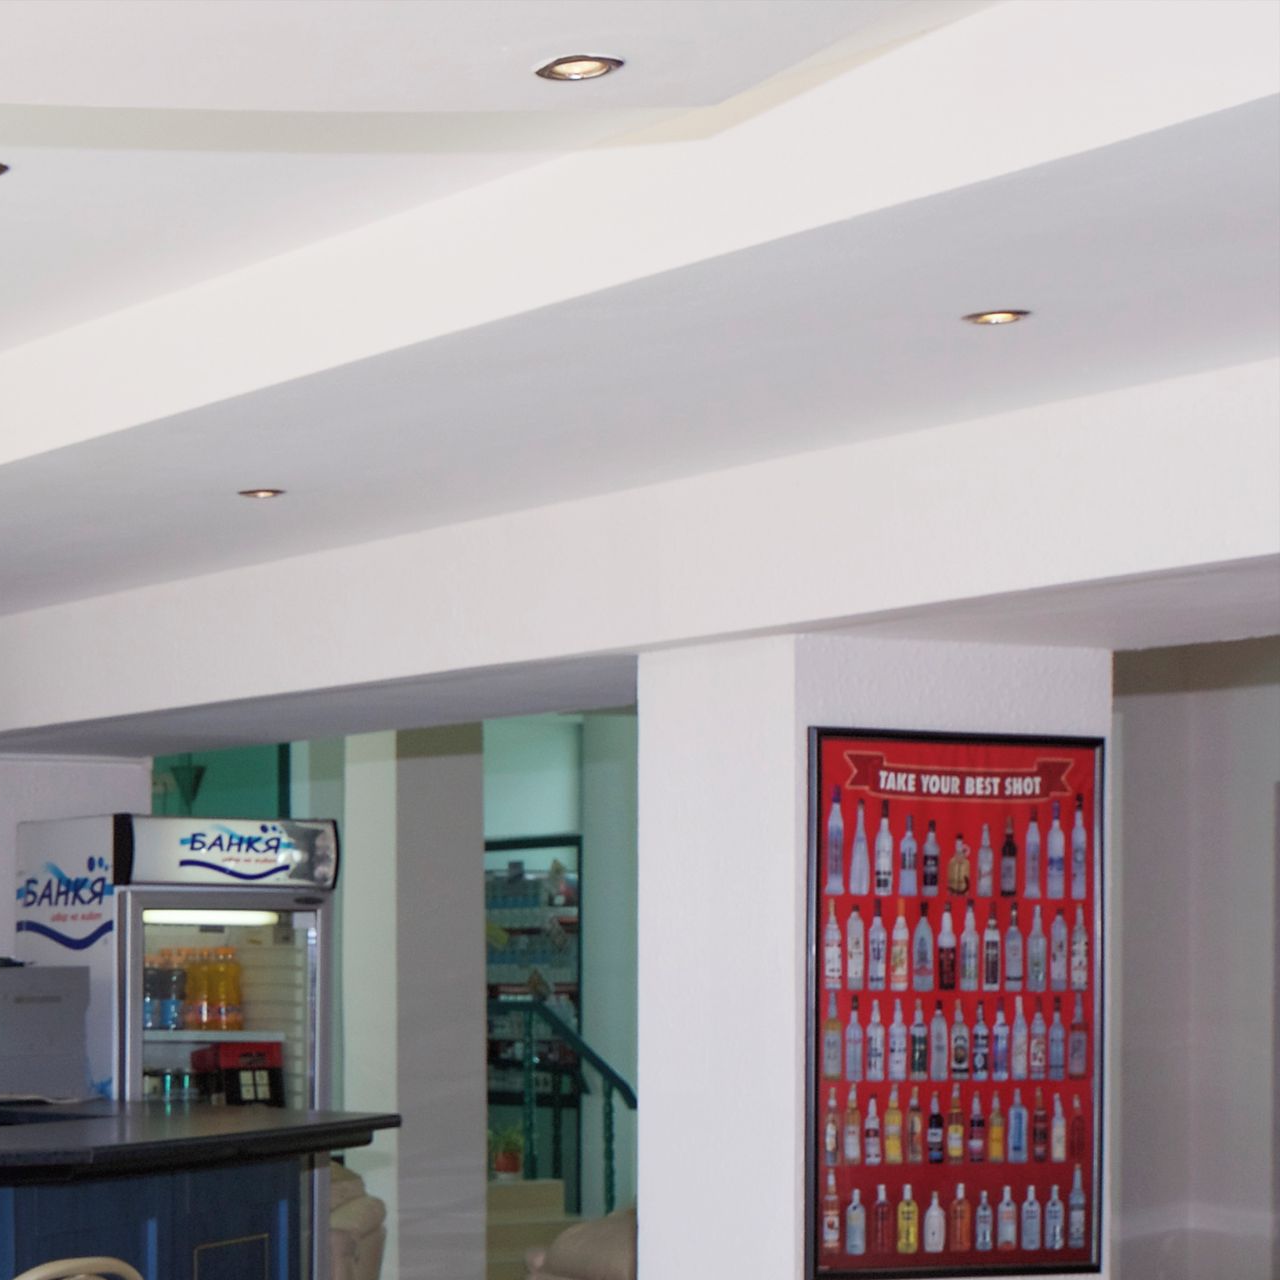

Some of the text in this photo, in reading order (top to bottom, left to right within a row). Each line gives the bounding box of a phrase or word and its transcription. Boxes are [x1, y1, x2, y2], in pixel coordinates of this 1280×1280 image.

[878, 770, 1042, 796] TAKE YOUR BEST SHOT
[190, 832, 281, 854] БАНКЯ
[23, 876, 107, 908] БАНКЯ
